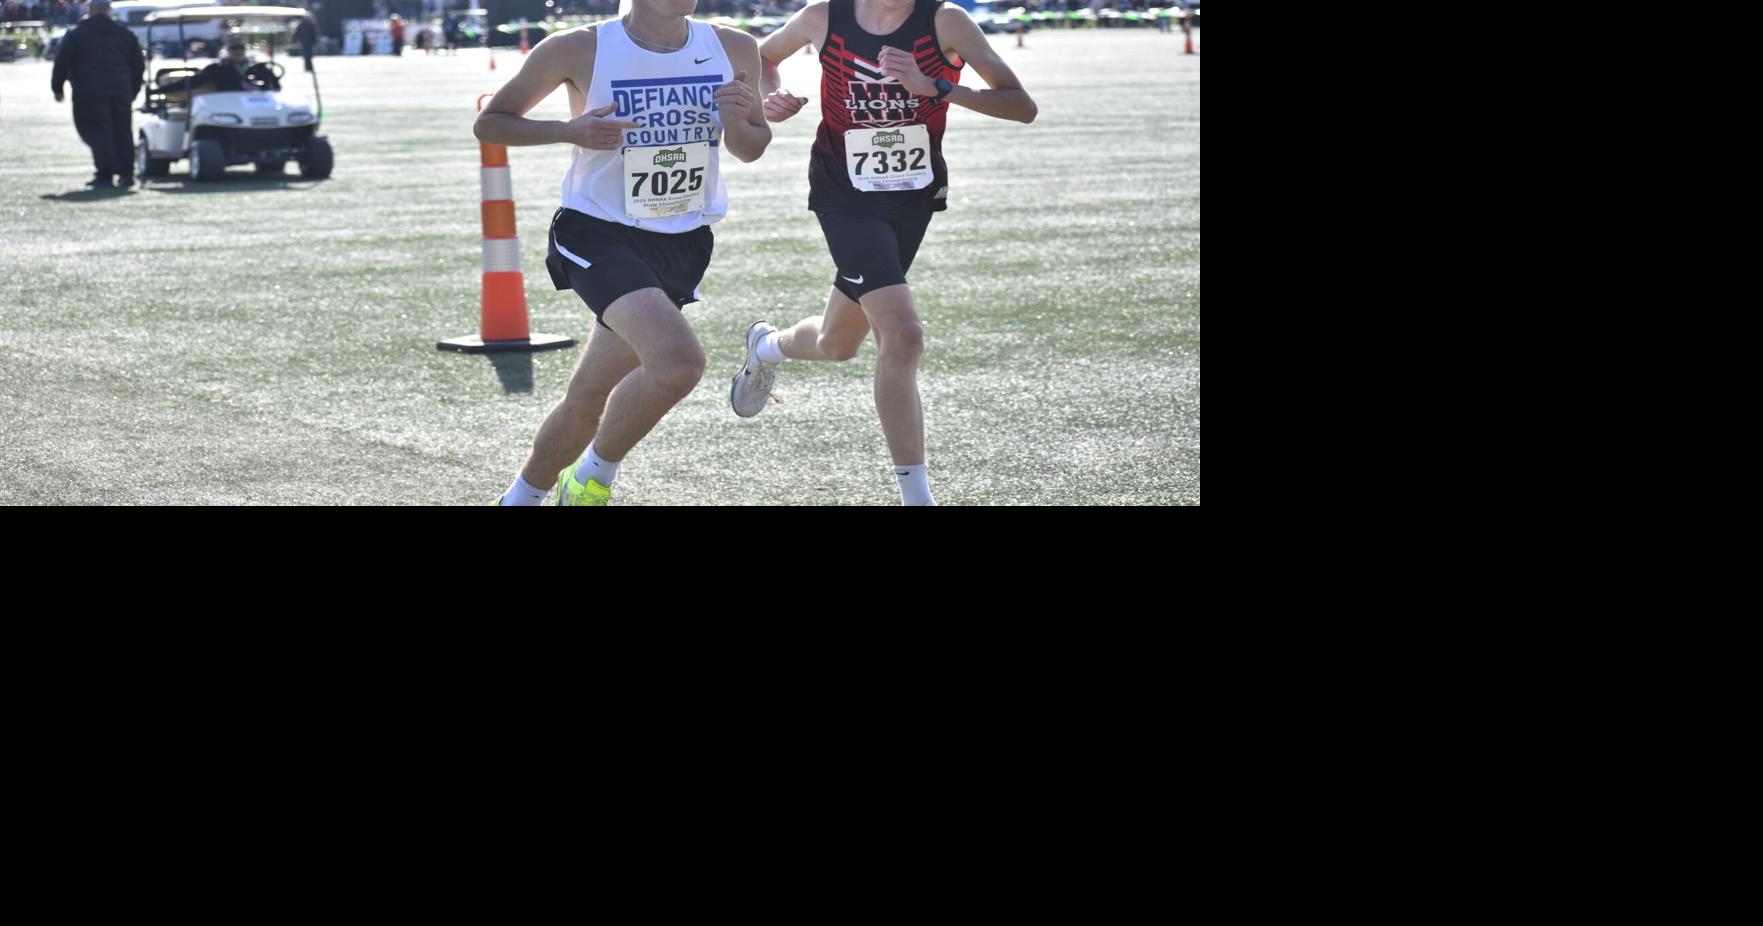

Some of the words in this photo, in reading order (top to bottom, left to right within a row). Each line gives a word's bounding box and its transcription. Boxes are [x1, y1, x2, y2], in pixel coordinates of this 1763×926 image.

[844, 98, 920, 110] LIONS
[632, 109, 711, 129] CROSS
[626, 126, 716, 145] COUNTRY
[873, 134, 903, 145] OHSAA
[654, 152, 685, 164] OHSAA
[853, 147, 927, 176] 7332
[631, 166, 705, 197] 7025
